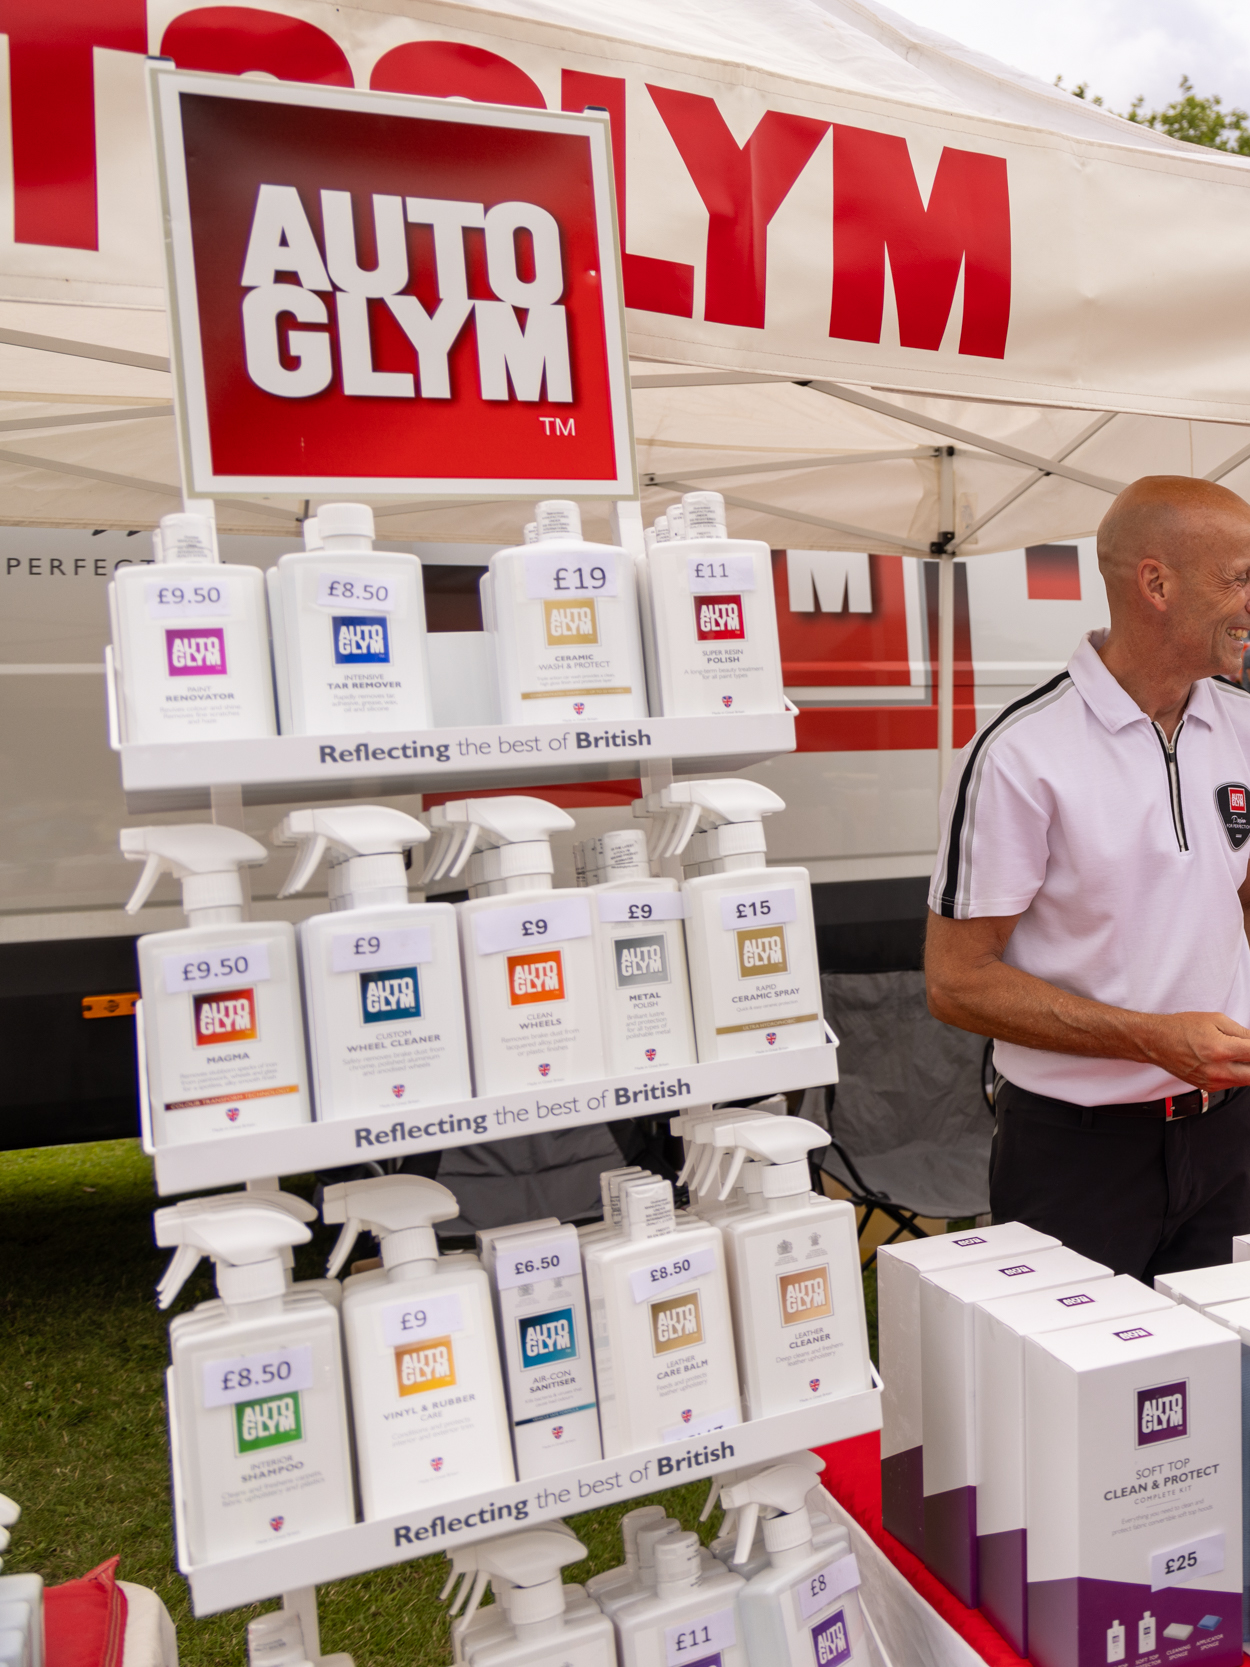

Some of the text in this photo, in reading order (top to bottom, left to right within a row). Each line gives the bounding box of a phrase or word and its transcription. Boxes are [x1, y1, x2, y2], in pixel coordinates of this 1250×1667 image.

[0, 0, 1011, 359] TLYM
[241, 184, 564, 308] AUTO
[242, 284, 573, 403] GLYM
[540, 418, 575, 436] TM
[553, 567, 606, 590] £19
[695, 563, 728, 578] £11
[158, 587, 220, 604] £9.50
[328, 581, 388, 601] £8.50
[551, 607, 591, 622] AUTO
[700, 603, 738, 618] AUTO
[339, 625, 383, 640] AUTO
[551, 621, 592, 636] GLYM
[700, 617, 740, 631] GLYM
[173, 637, 219, 651] AUTO
[339, 638, 384, 655] GLYM
[172, 650, 221, 667] GLYM
[166, 693, 234, 702] RENOVATOR
[319, 729, 652, 765] Reflecting the best of British
[628, 904, 652, 919] £9
[736, 900, 771, 918] £15
[522, 919, 548, 936] £9
[353, 937, 380, 955] £9
[621, 945, 660, 964] AUTO
[744, 936, 781, 953] AUTO
[182, 956, 248, 981] £9.50
[621, 960, 662, 976] GLYM
[744, 950, 782, 967] GLYM
[514, 961, 558, 980] AUTO
[367, 977, 413, 997] AUTO
[514, 975, 559, 995] GLYM
[756, 984, 776, 992] RAPID
[367, 993, 415, 1012] GLYM
[629, 992, 661, 1001] METAL
[633, 1000, 658, 1009] POLISH
[732, 988, 800, 1003] CERAMIC SPRAY
[200, 999, 249, 1020] AUTO
[527, 1012, 553, 1020] CLEAN
[200, 1014, 251, 1035] GLYM
[519, 1018, 562, 1030] WHEELS
[347, 1034, 441, 1053] WHEEL CLEANER
[376, 1030, 412, 1040] CUSTOM
[207, 1052, 249, 1064] MAGMA
[354, 1078, 692, 1148] Reflecting the best of British
[515, 1255, 560, 1275] £6.50
[650, 1259, 690, 1282] £8.50
[787, 1278, 824, 1299] AUTO
[786, 1291, 826, 1313] GLYM
[400, 1310, 426, 1330] £9
[658, 1304, 695, 1326] AUTO
[526, 1319, 569, 1342] AUTO
[658, 1318, 697, 1342] GLYM
[795, 1328, 824, 1339] LEATHER
[526, 1334, 570, 1357] GLYM
[789, 1334, 830, 1349] CLEANER
[402, 1346, 448, 1370] AUTO
[667, 1355, 695, 1368] LEATHER
[222, 1361, 291, 1390] £8.50
[402, 1361, 450, 1386] GLYM
[533, 1370, 571, 1384] AIR-CON
[657, 1359, 708, 1380] CARE BALM
[530, 1377, 576, 1393] SANITISER
[243, 1398, 294, 1425] AUTO
[383, 1394, 475, 1421] VINYL & RUBBER
[420, 1411, 442, 1421] CARE
[1142, 1394, 1182, 1418] AUTO
[242, 1413, 295, 1441] GLYM
[1142, 1409, 1183, 1434] GLYM
[241, 1462, 304, 1483] SHAMPOO
[251, 1455, 293, 1471] INTERIOR
[1136, 1458, 1190, 1480] SOFT TOP
[1104, 1464, 1219, 1501] CLEAN & PROTECT
[393, 1440, 735, 1548] Reflecting the best of British
[1134, 1485, 1192, 1505] COMPLETE KIT
[1165, 1552, 1197, 1575] £25
[810, 1574, 827, 1598] £8
[676, 1626, 711, 1651] £11
[818, 1622, 844, 1649] AUTO
[818, 1635, 846, 1664] GLYM
